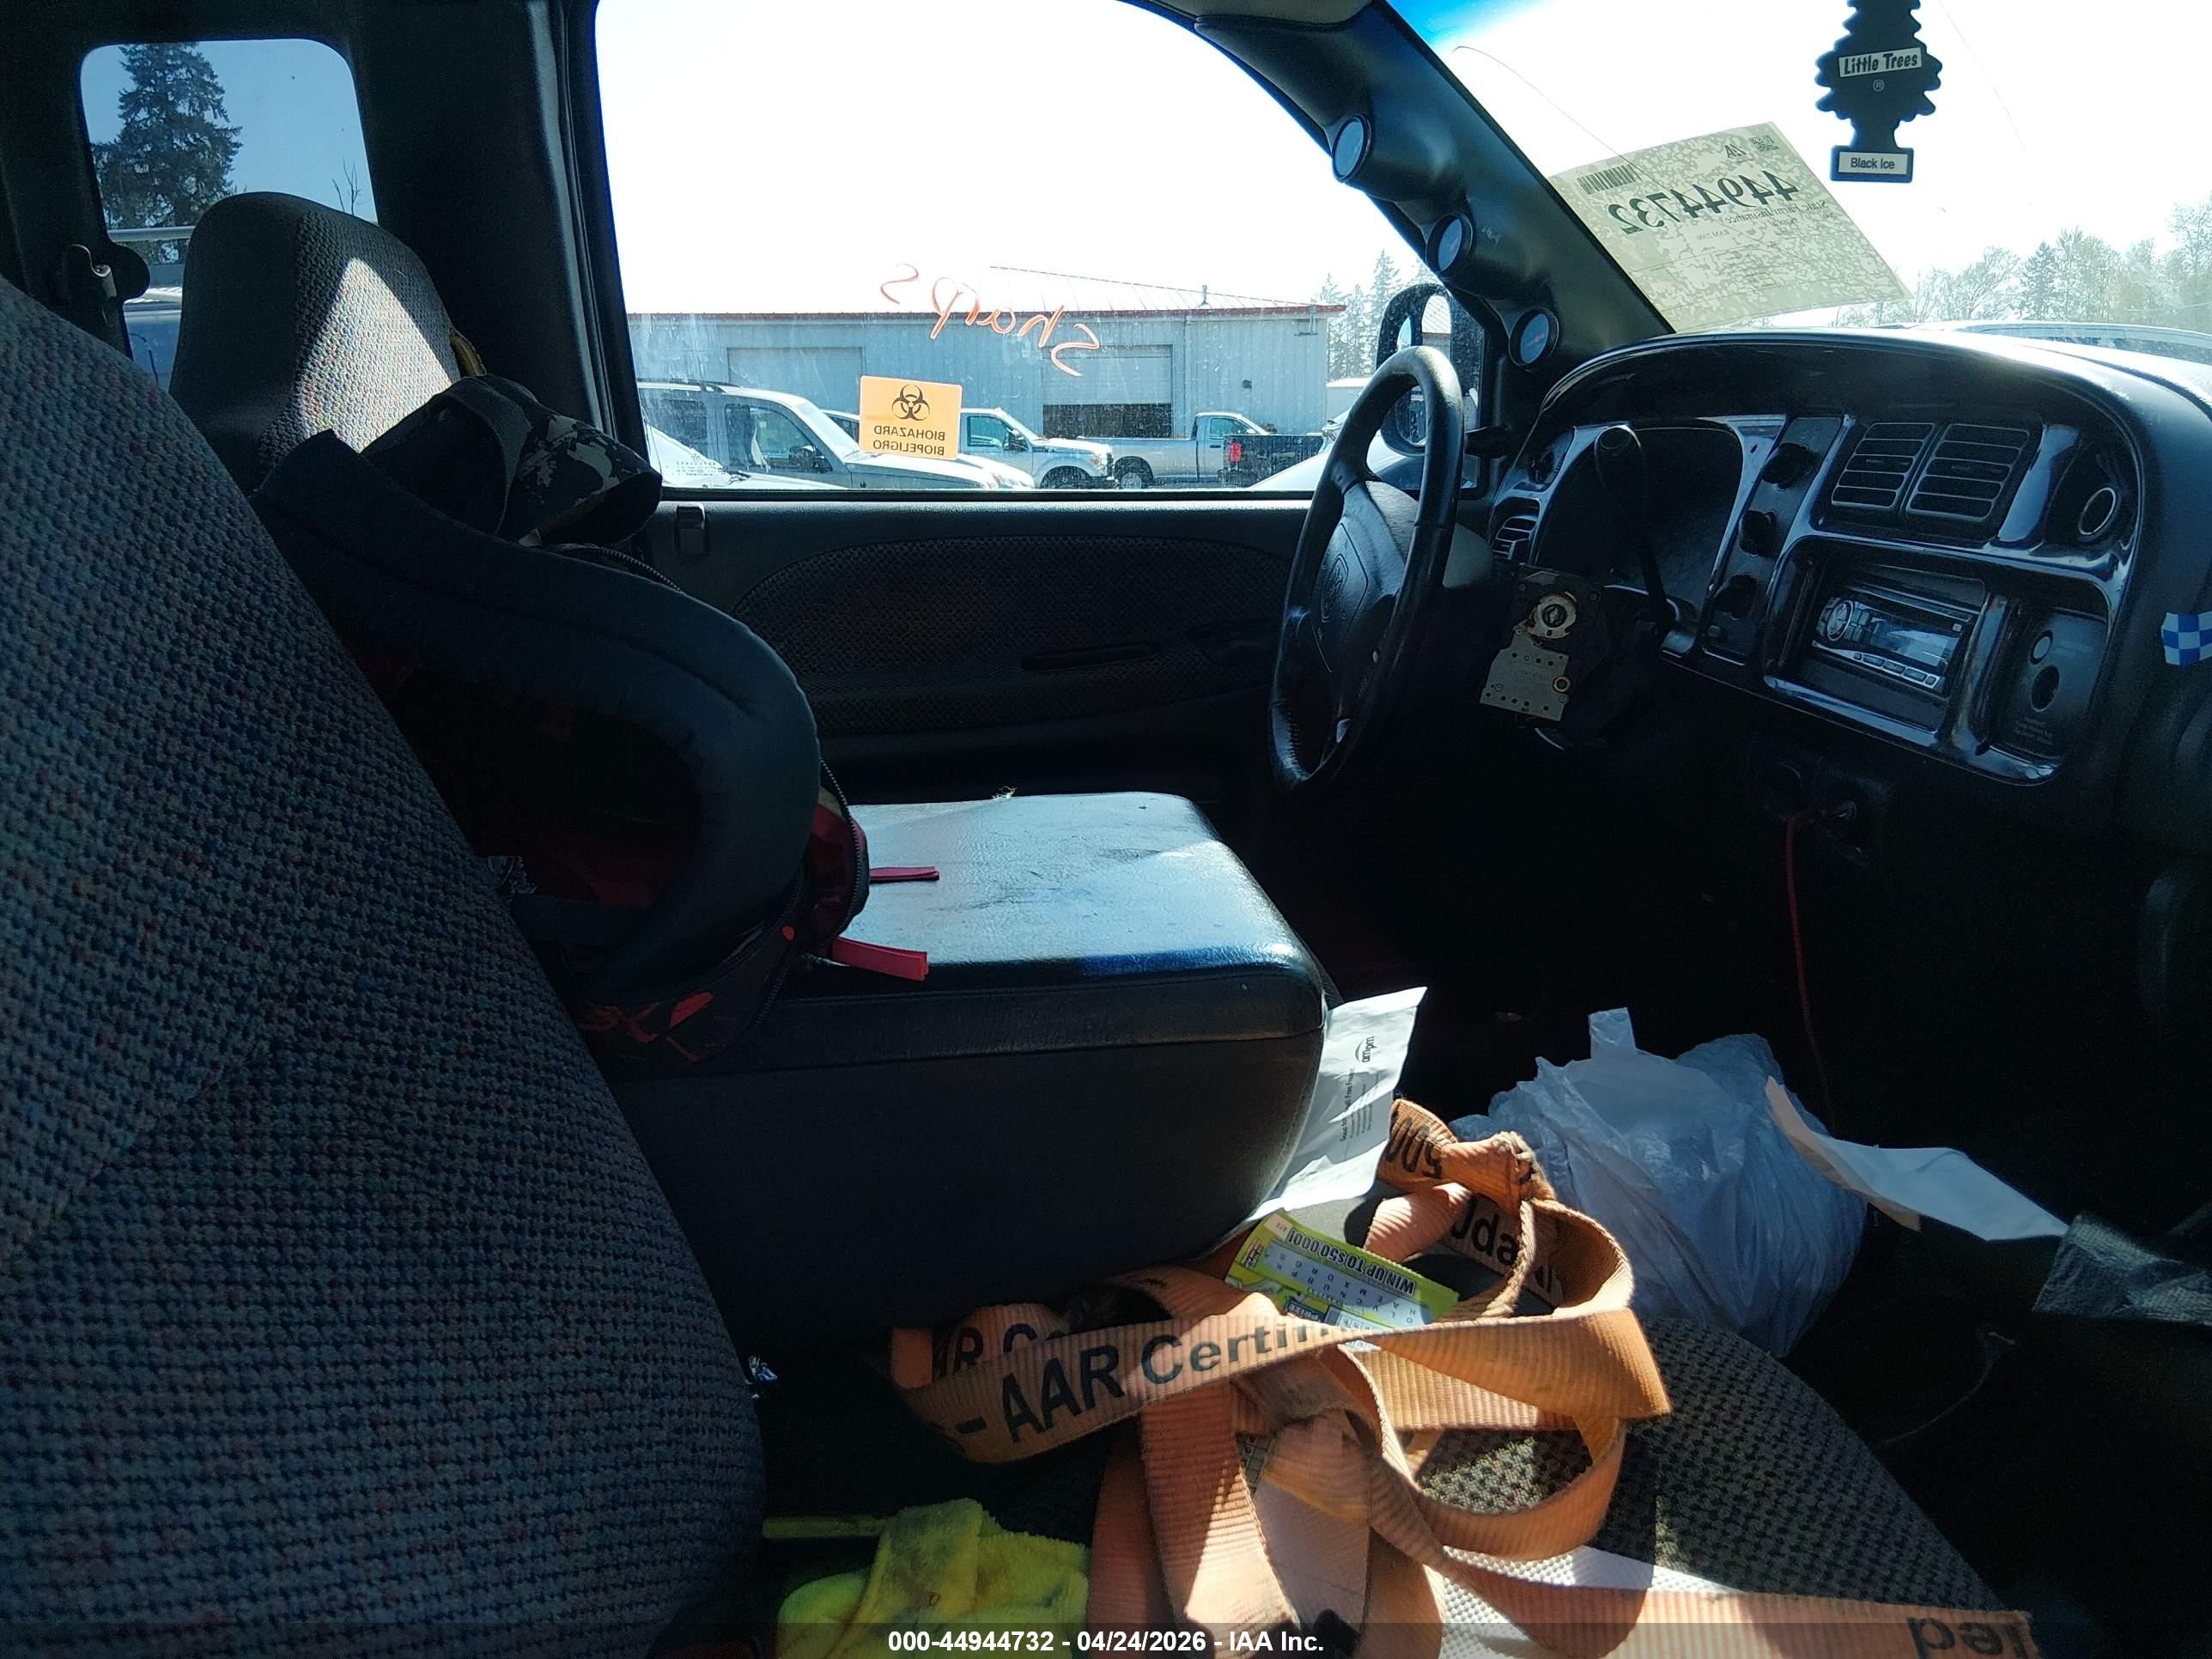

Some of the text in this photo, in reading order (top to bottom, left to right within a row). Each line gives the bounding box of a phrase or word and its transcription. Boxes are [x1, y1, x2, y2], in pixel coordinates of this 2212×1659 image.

[1844, 52, 1918, 75] Little Trees
[1850, 157, 1896, 170] Black Ice
[1346, 1254, 1364, 1274] TO
[1367, 1264, 1386, 1282] UP
[1387, 1272, 1414, 1294] WIN
[1000, 1345, 1125, 1443] AAR
